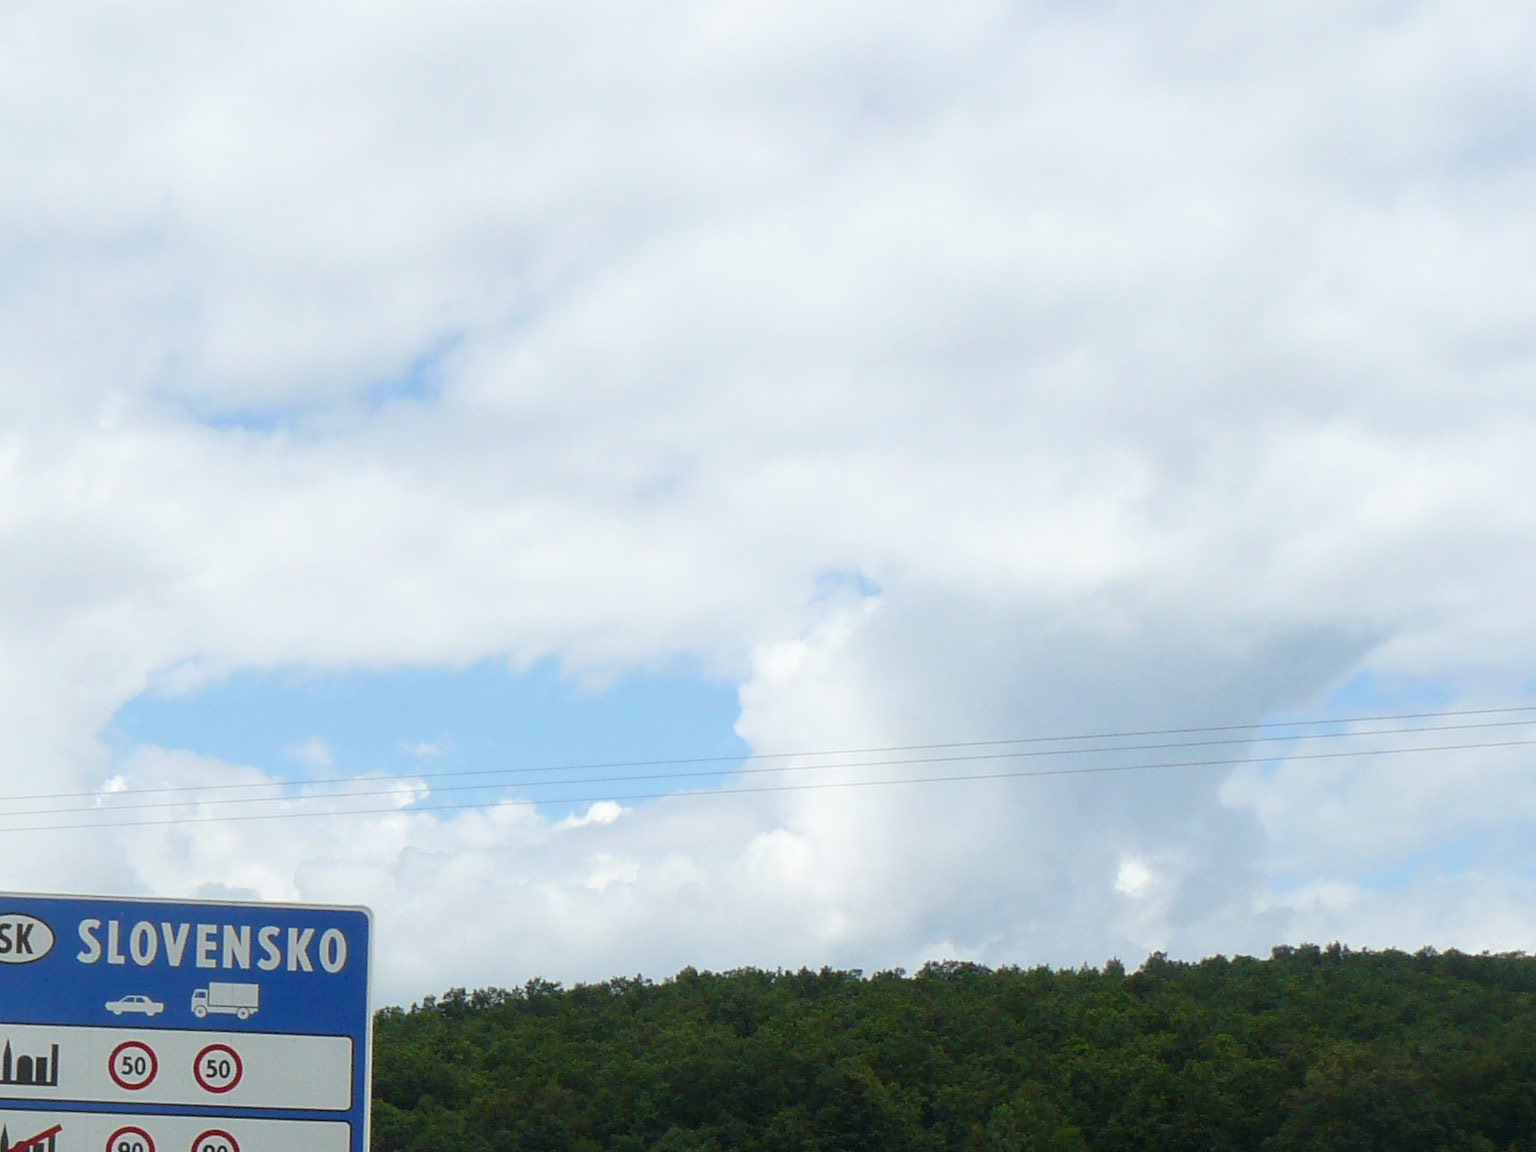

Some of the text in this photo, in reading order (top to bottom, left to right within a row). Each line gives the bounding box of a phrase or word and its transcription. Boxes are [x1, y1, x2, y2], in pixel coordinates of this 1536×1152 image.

[76, 918, 348, 974] SLOVENSKO
[121, 1056, 146, 1076] 50
[206, 1059, 231, 1079] 50
